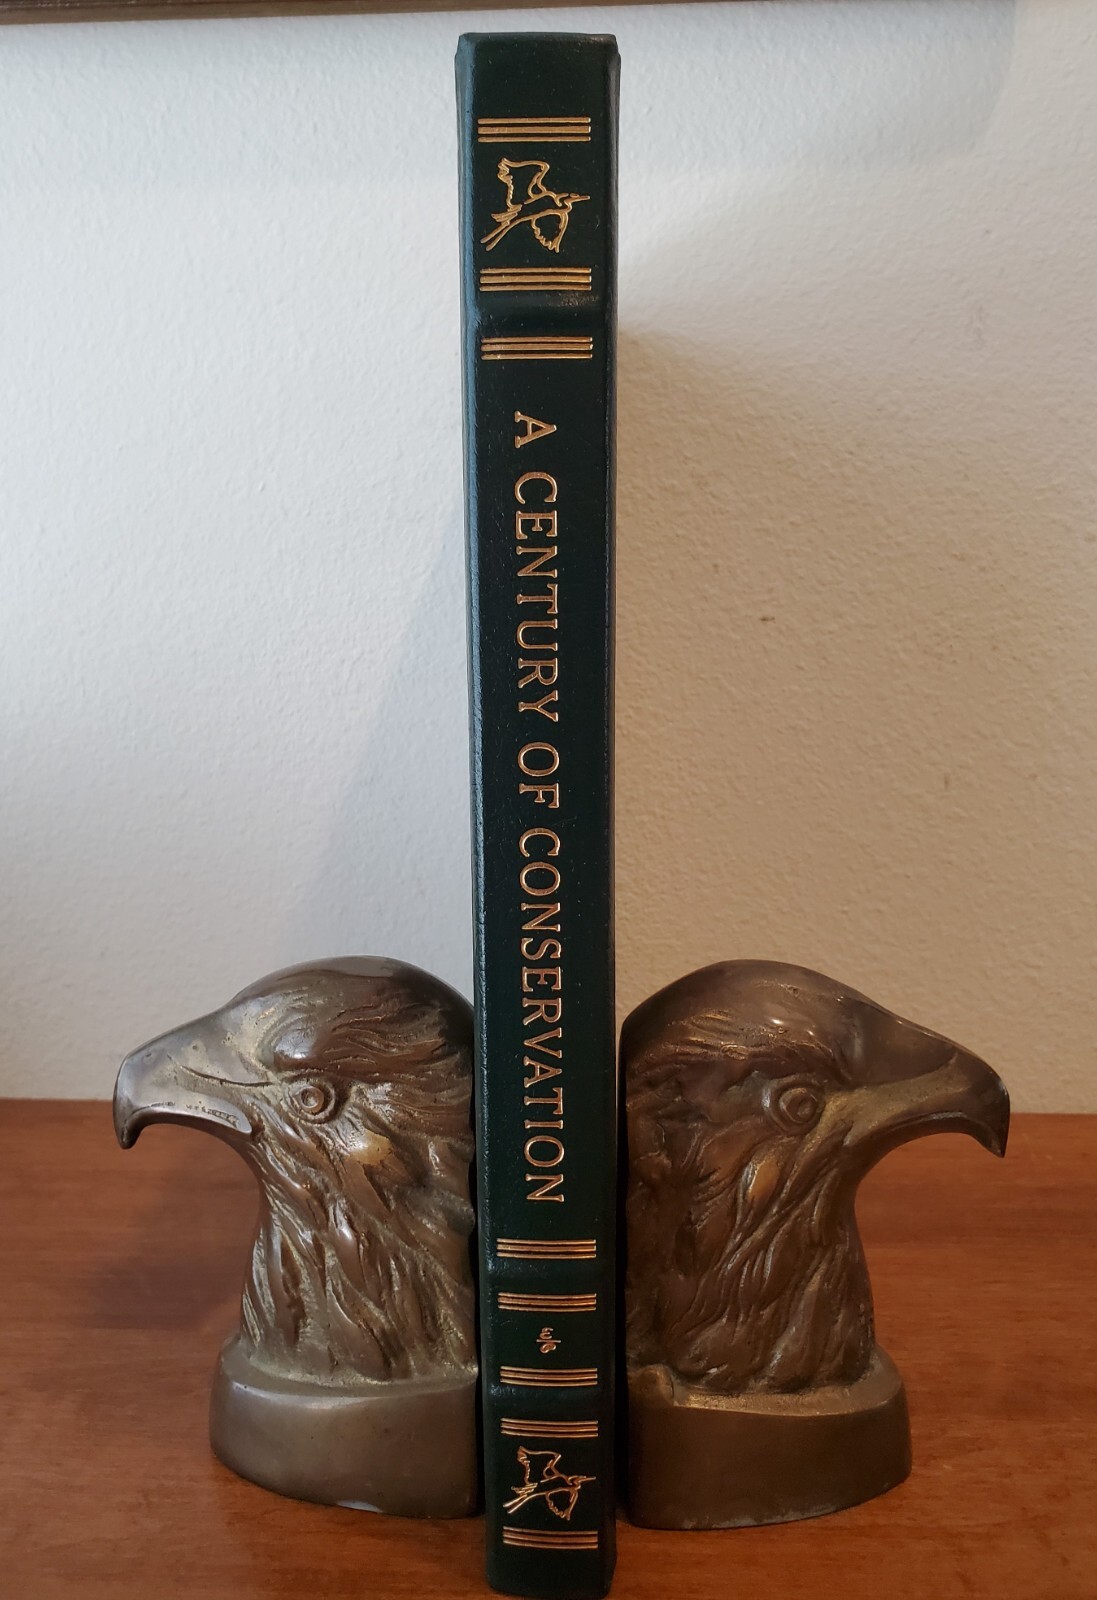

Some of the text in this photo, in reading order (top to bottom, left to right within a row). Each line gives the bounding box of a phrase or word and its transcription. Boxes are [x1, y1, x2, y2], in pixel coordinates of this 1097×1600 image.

[514, 410, 565, 1203] A CENTURY OF CONSERVATION
